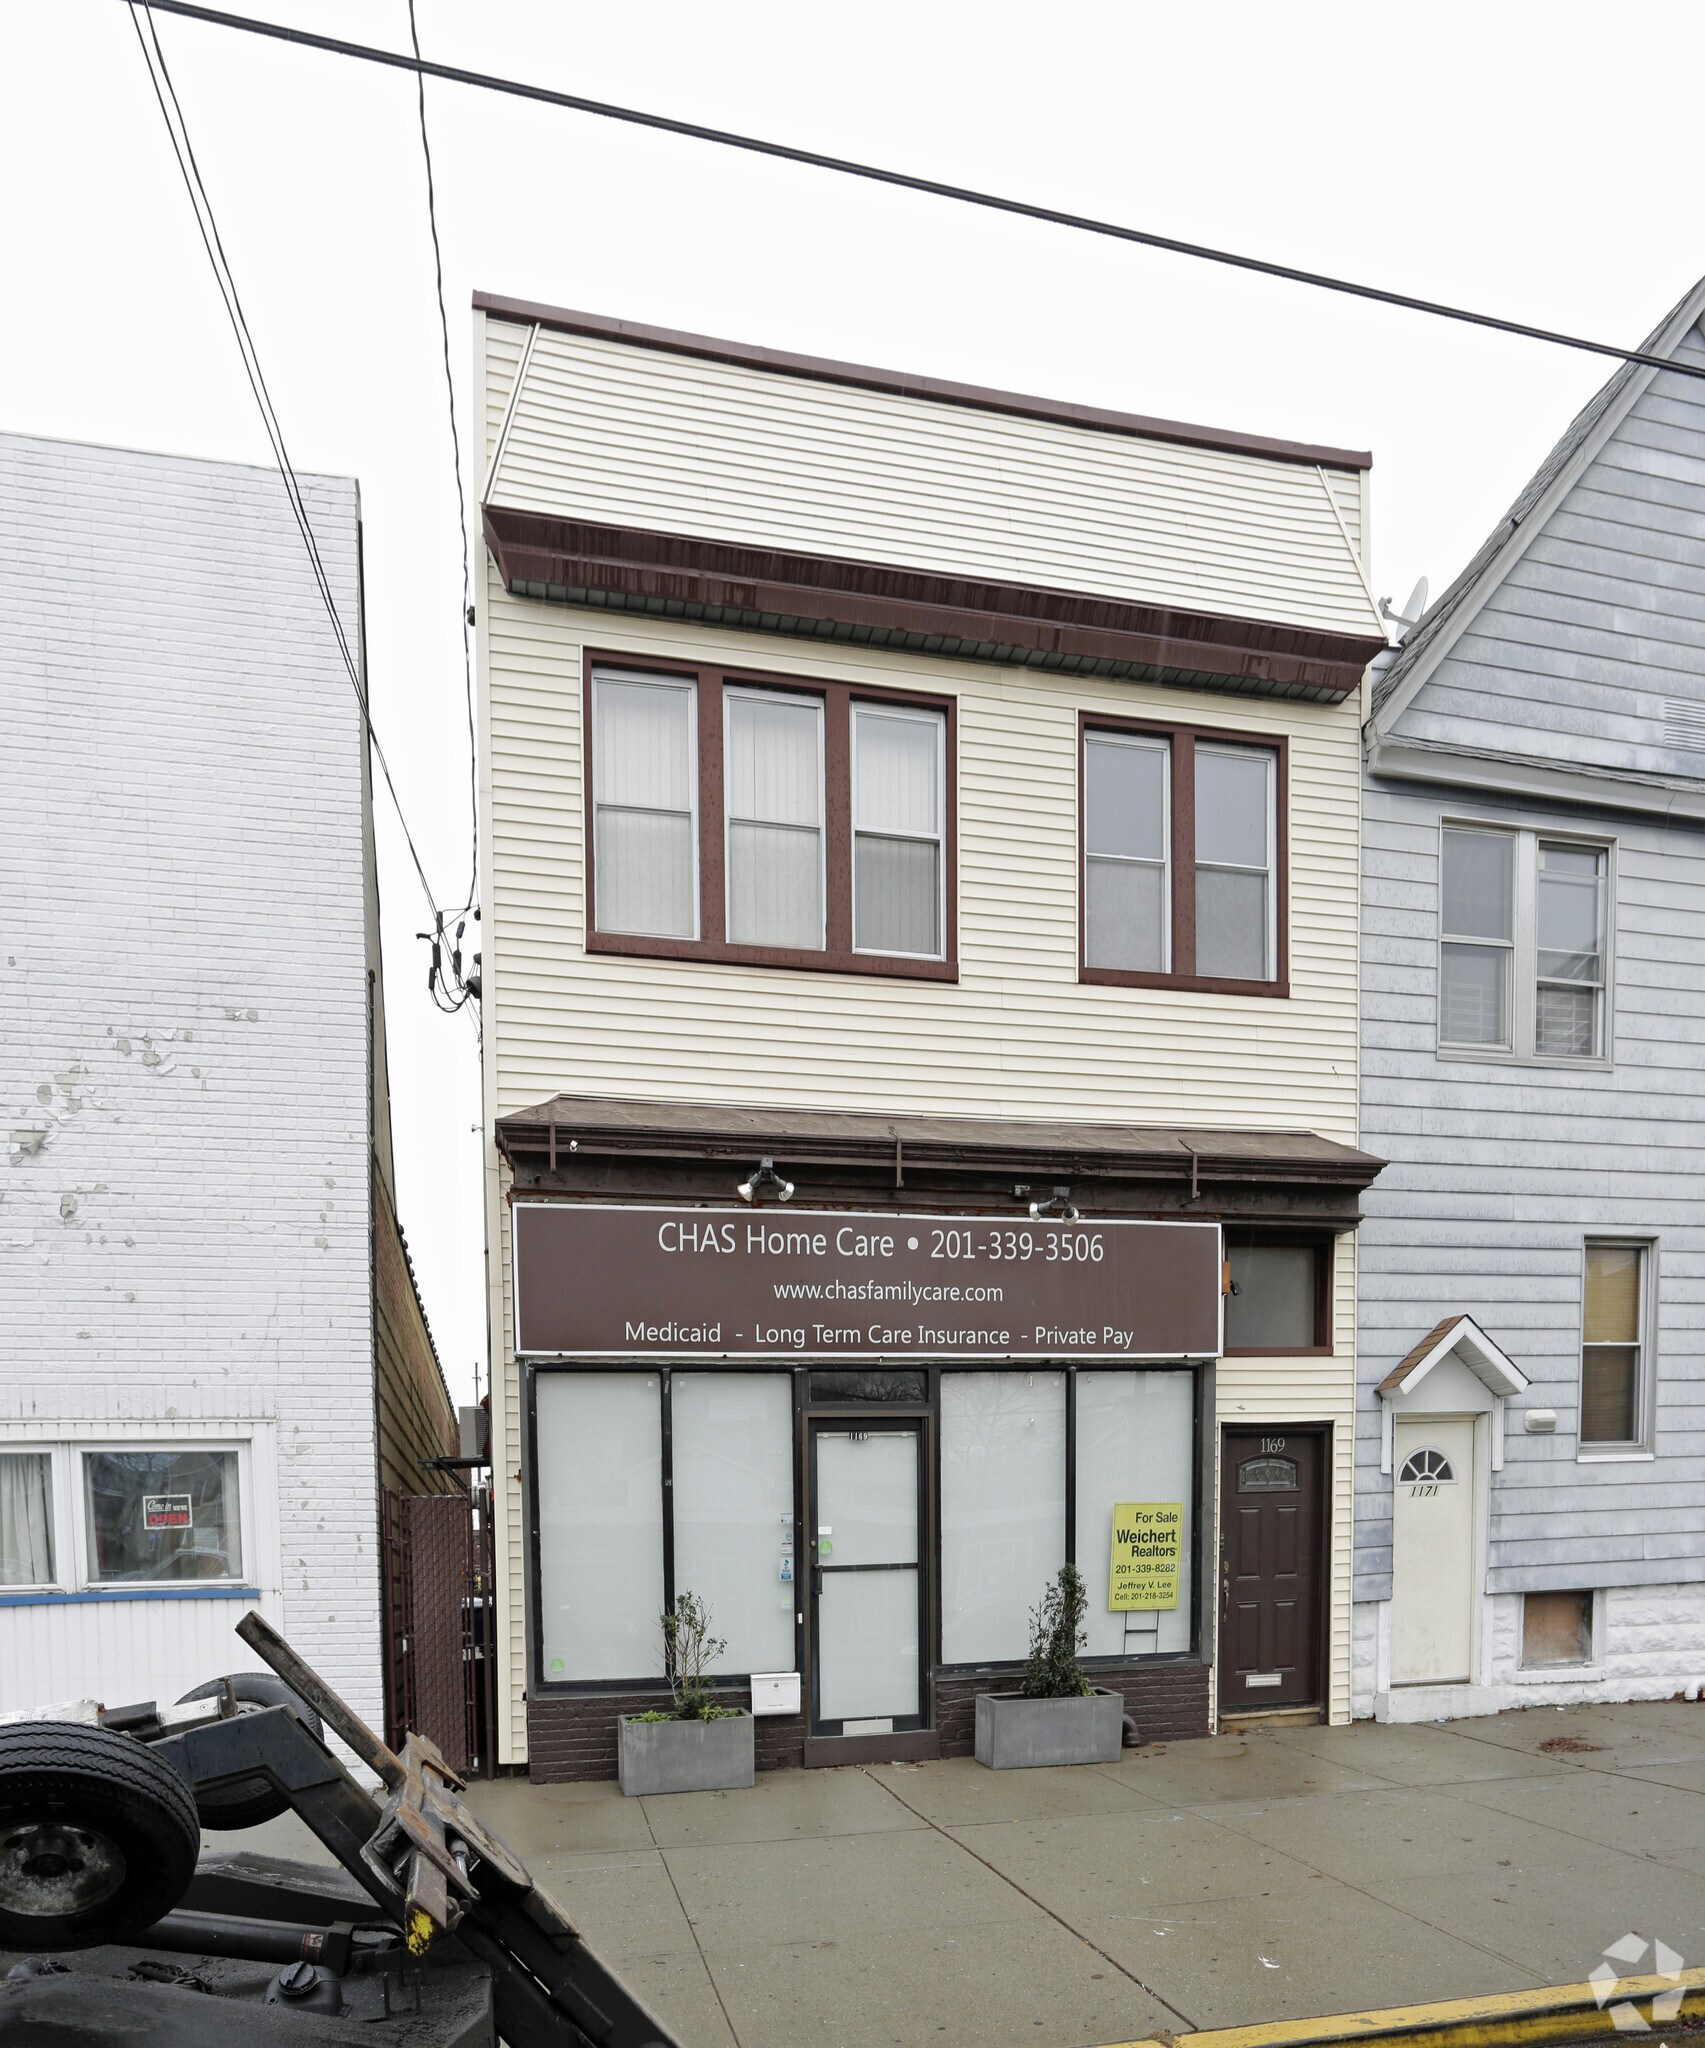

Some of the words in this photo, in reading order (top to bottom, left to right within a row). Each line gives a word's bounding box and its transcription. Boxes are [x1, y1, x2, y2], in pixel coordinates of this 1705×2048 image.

[657, 1221, 736, 1253] CHAS
[747, 1224, 827, 1255] Home
[836, 1227, 895, 1257] Care
[930, 1229, 1105, 1262] 201-339-3506
[773, 1278, 1004, 1306] www.chasfamilycare.com
[624, 1321, 722, 1343] Medicaid
[755, 1323, 806, 1348] Long
[812, 1324, 862, 1345] Term
[867, 1324, 913, 1345] Care
[917, 1325, 1010, 1345] Insurance
[1034, 1326, 1097, 1345] Private
[1102, 1327, 1134, 1350] Pay
[850, 1432, 868, 1440] 1169
[1261, 1437, 1286, 1453] 1169
[1411, 1485, 1438, 1497] 1171
[148, 1513, 188, 1524] OPEN
[1135, 1512, 1153, 1523] For
[1155, 1511, 1178, 1523] Sale
[1131, 1545, 1176, 1557] Realtors
[1115, 1564, 1175, 1573] 201-339-8282
[1117, 1581, 1146, 1591] Jeffrey
[1148, 1581, 1155, 1589] V.
[1157, 1581, 1172, 1589] Lee
[1114, 1592, 1130, 1601] Cell:
[1131, 1592, 1173, 1600] 201-218-3254
